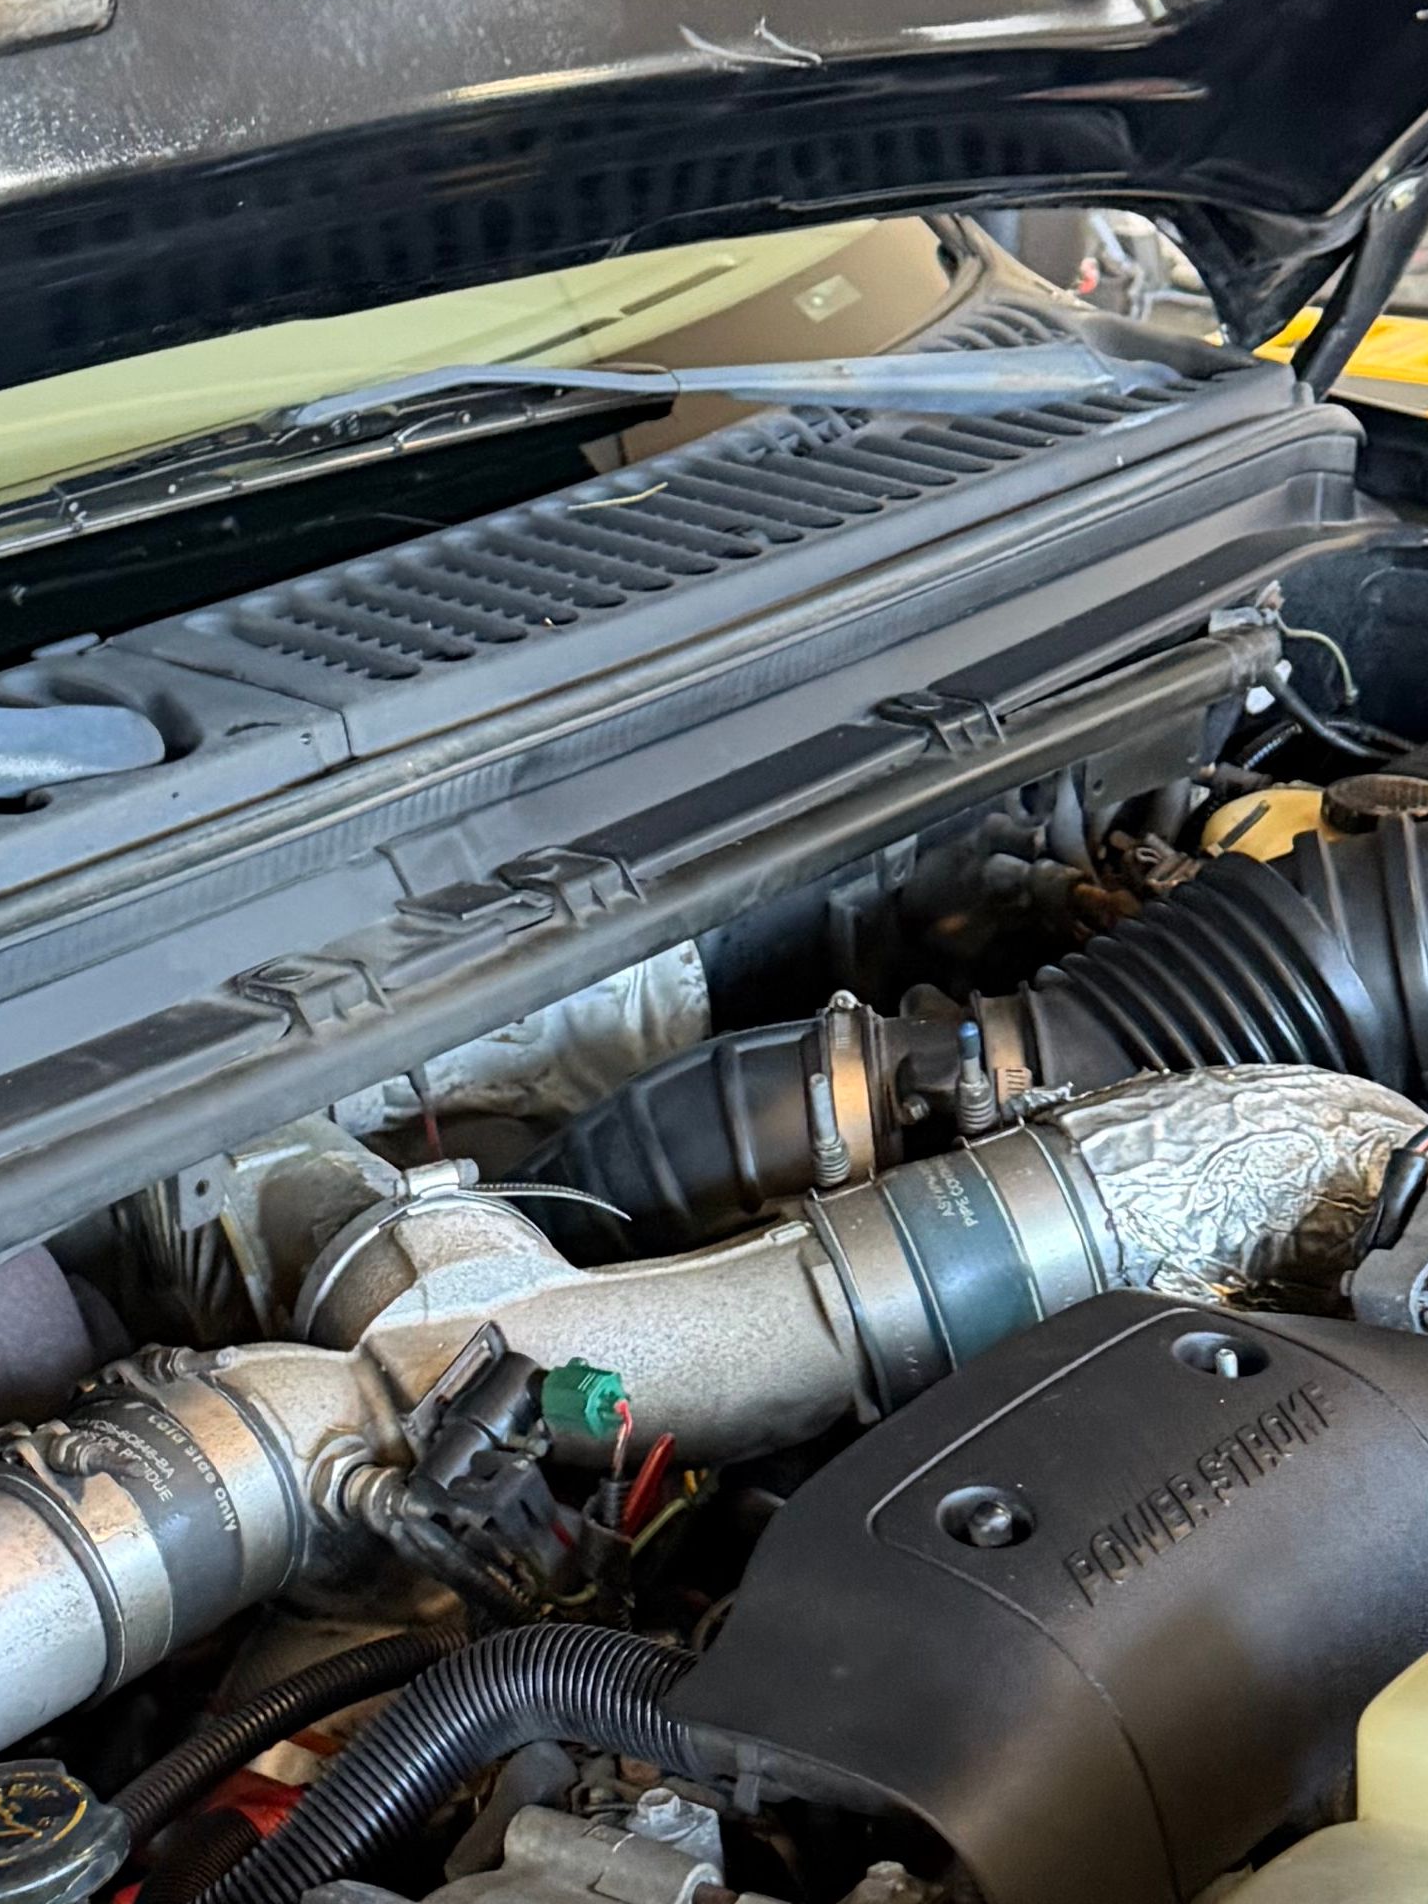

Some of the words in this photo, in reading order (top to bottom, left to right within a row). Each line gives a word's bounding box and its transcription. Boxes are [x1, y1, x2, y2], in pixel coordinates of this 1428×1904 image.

[954, 1195, 979, 1228] PIPE
[184, 1444, 217, 1483] Side
[213, 1487, 240, 1533] Only
[1063, 1474, 1210, 1607] POWER
[1199, 1380, 1337, 1505] STROKE
